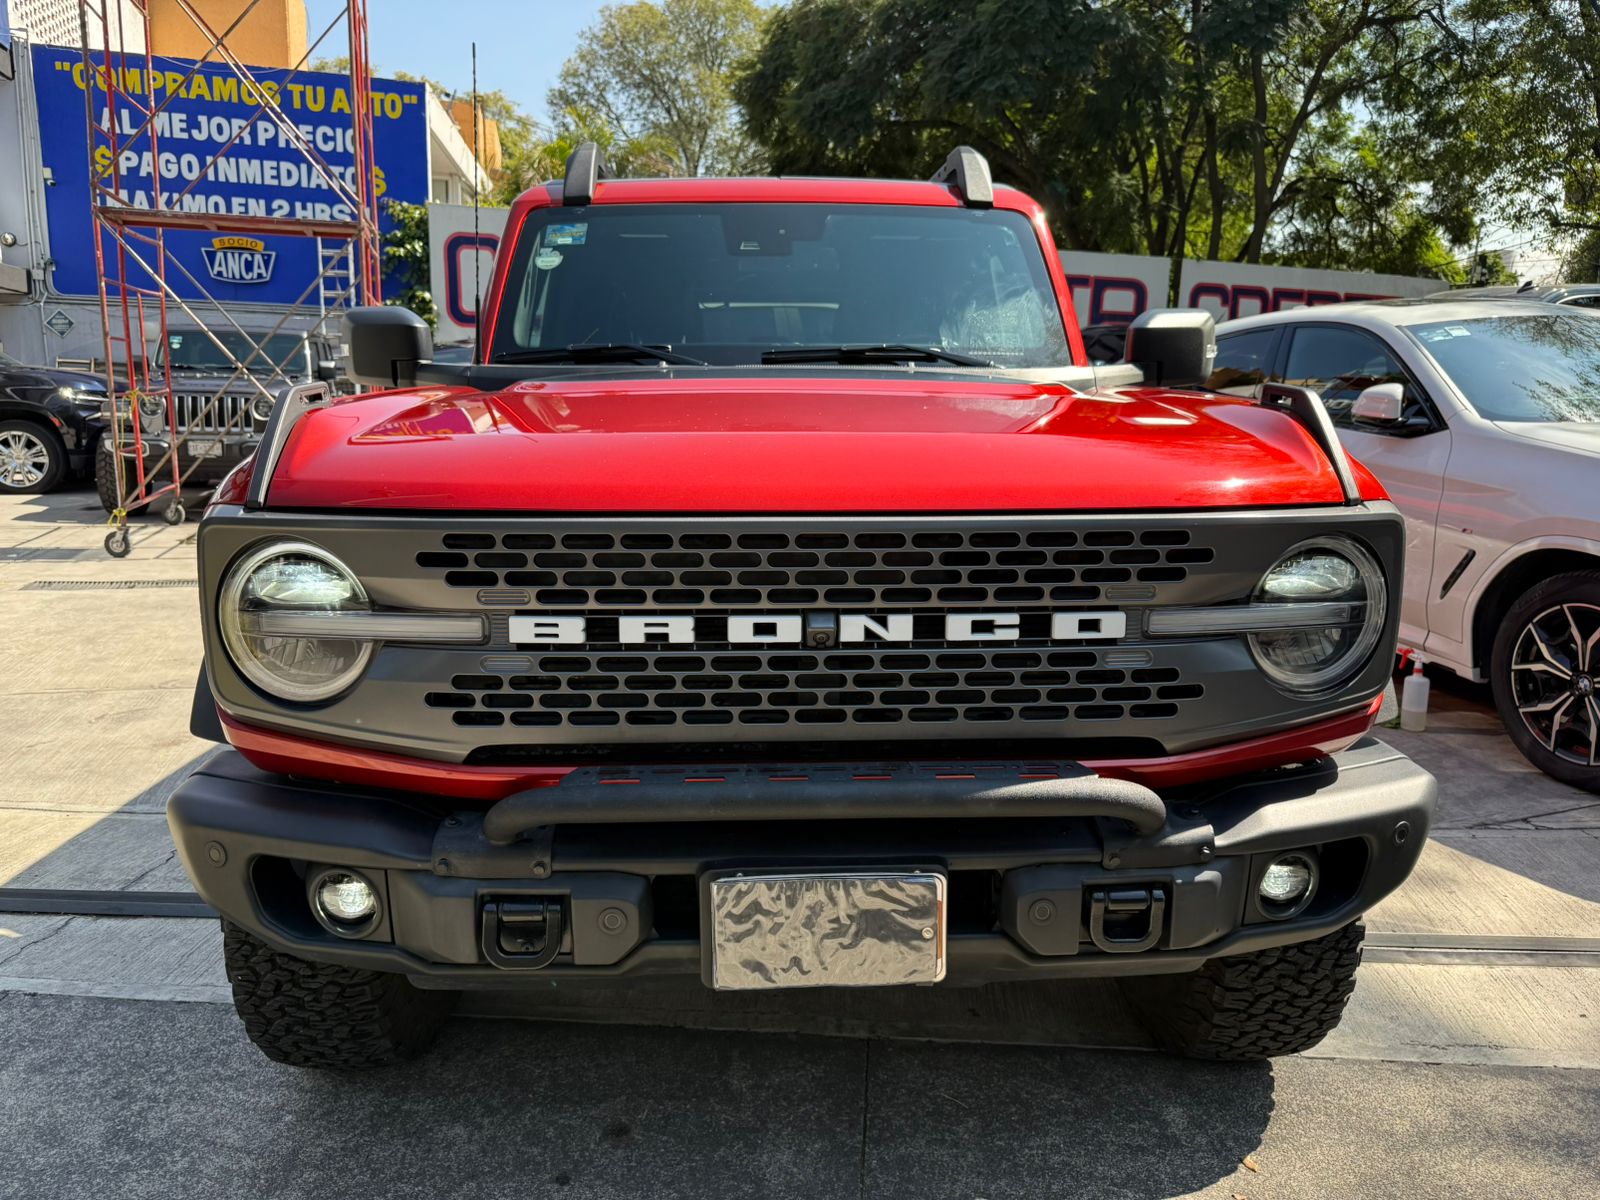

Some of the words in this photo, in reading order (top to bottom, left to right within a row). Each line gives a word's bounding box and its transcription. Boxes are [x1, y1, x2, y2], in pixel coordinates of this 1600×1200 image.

[288, 83, 325, 112] TU
[331, 88, 417, 119] ATO"
[100, 107, 139, 135] AL
[148, 111, 251, 146] MEJOR
[117, 150, 200, 181] PAGO
[231, 196, 266, 217] EN
[271, 198, 290, 218] 2
[218, 237, 258, 249] SOCIO
[213, 251, 267, 280] ANCA
[508, 612, 1127, 645] BRONCO
